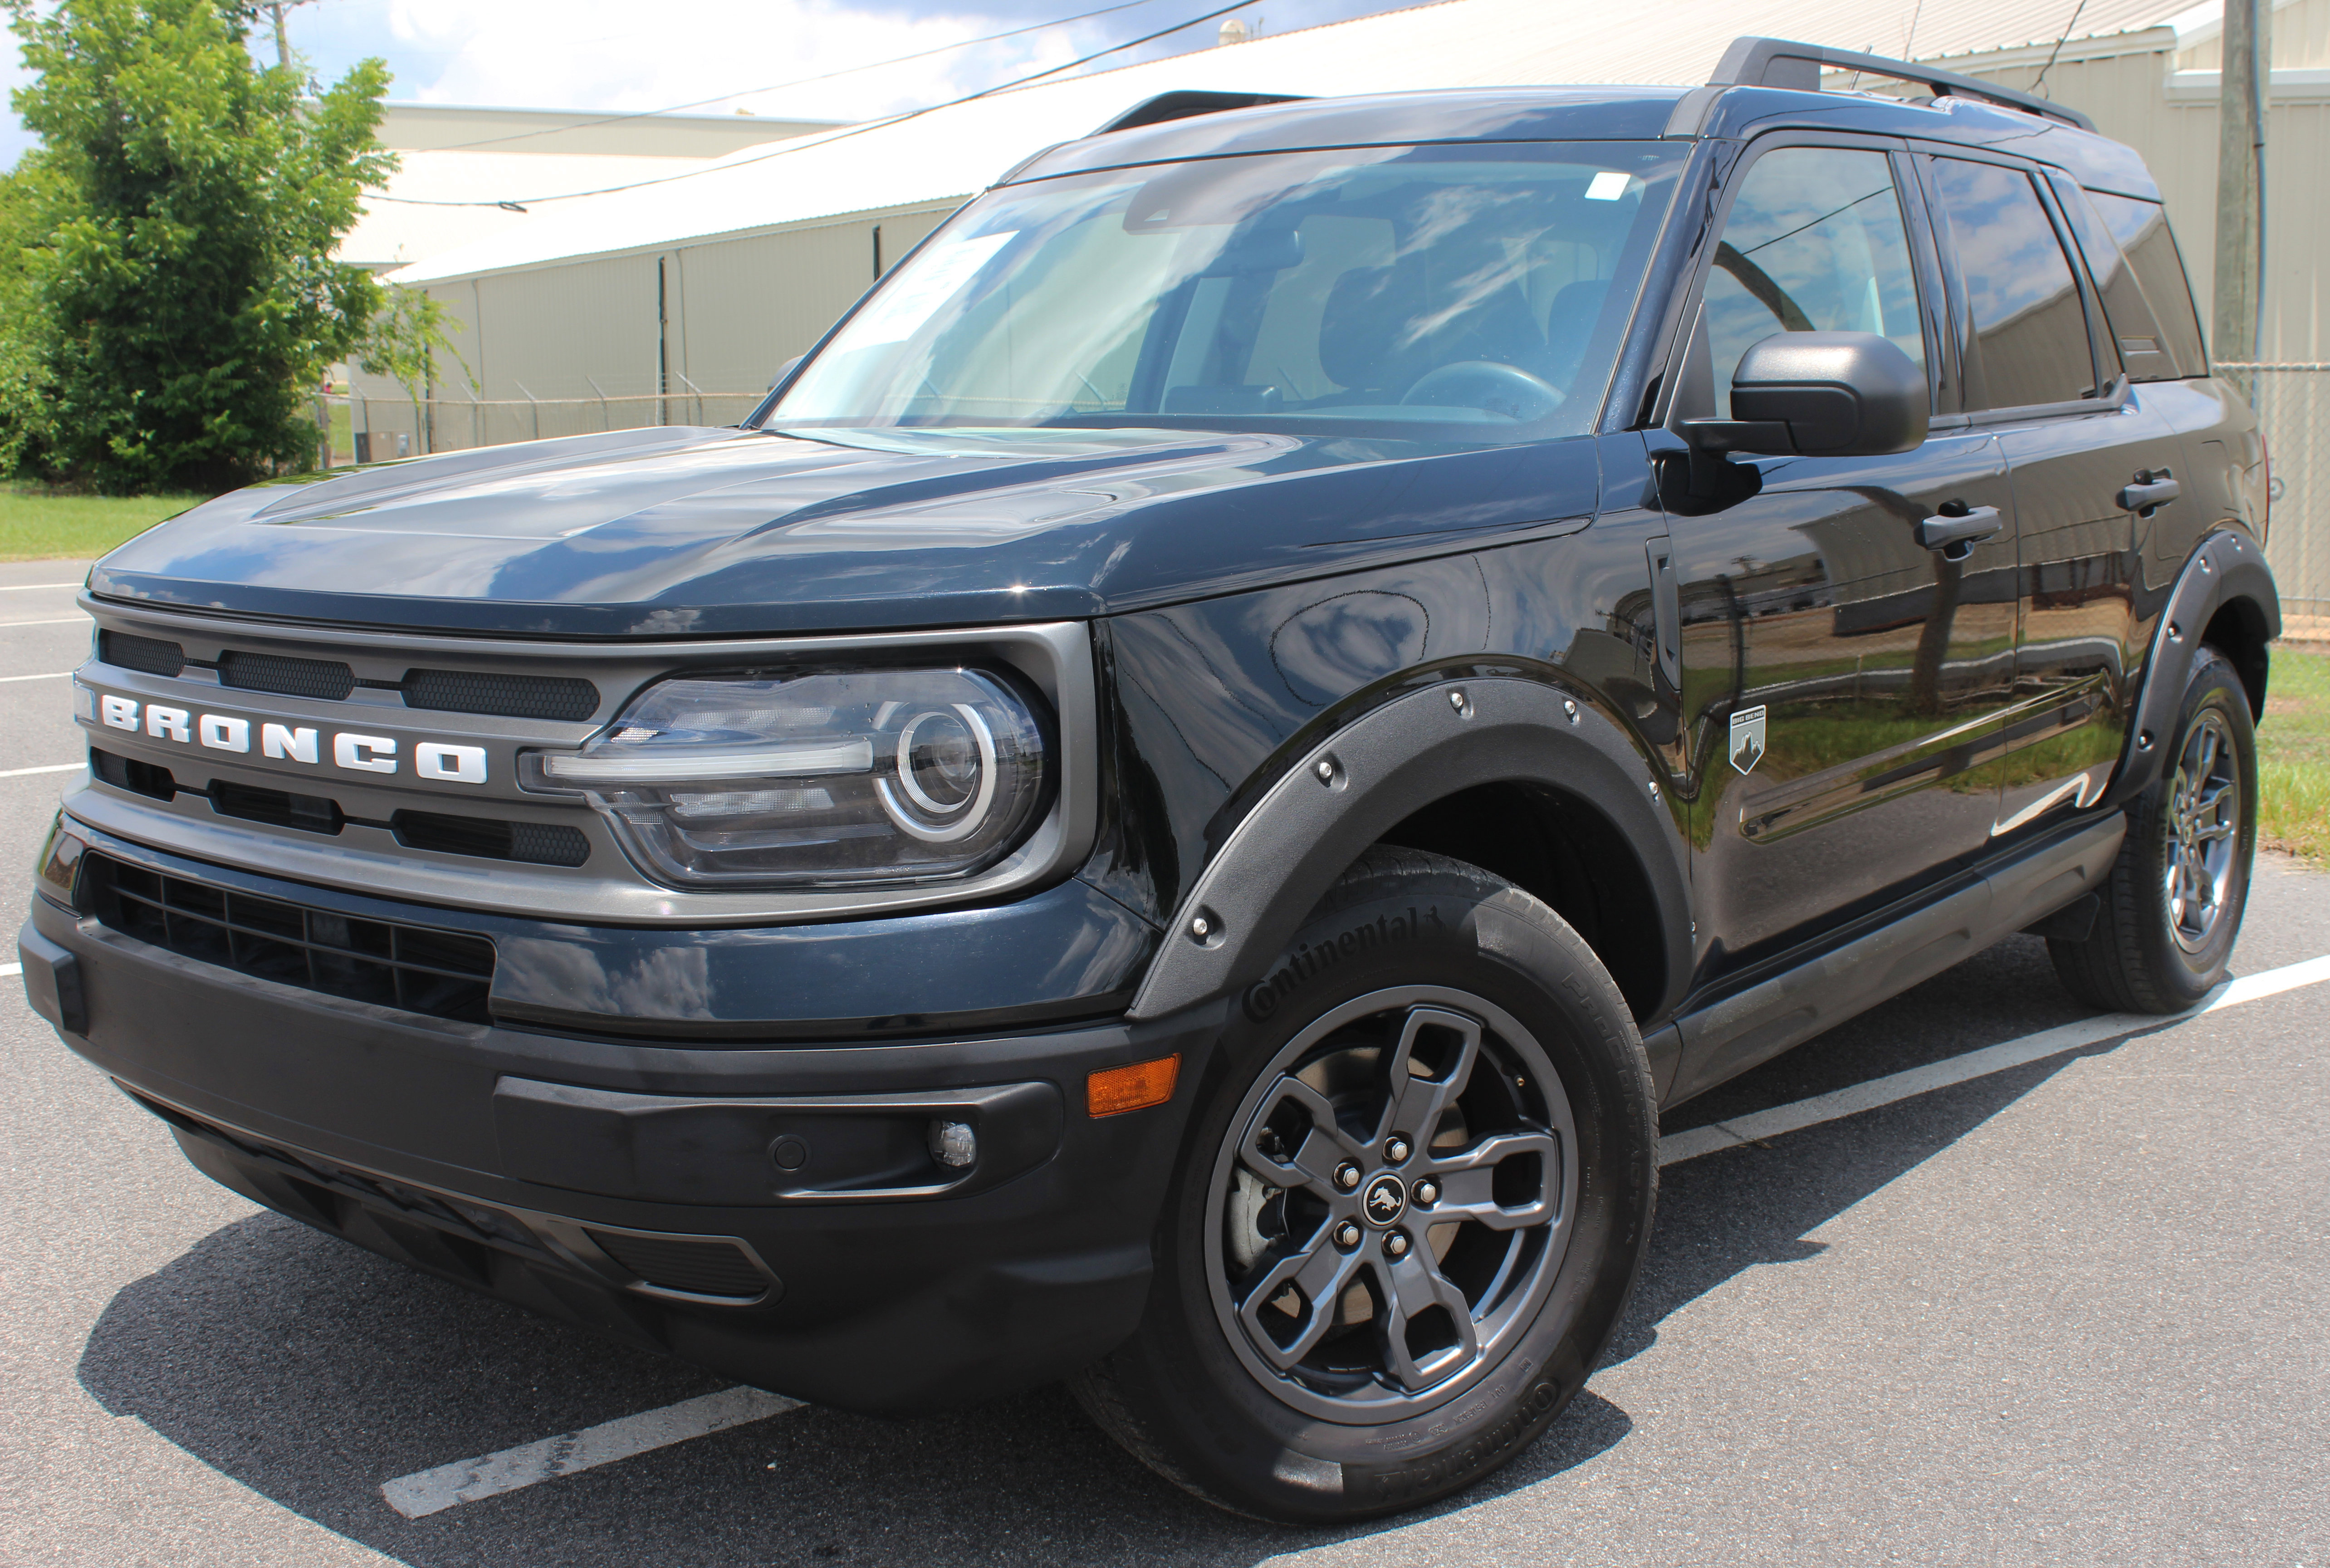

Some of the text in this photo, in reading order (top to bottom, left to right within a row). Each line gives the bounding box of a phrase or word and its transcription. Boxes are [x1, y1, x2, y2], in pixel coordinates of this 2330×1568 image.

[102, 694, 488, 784] BRONCO
[1745, 710, 1764, 720] BEND
[1242, 907, 1417, 1024] Continental
[1405, 1376, 1561, 1496] Continental
